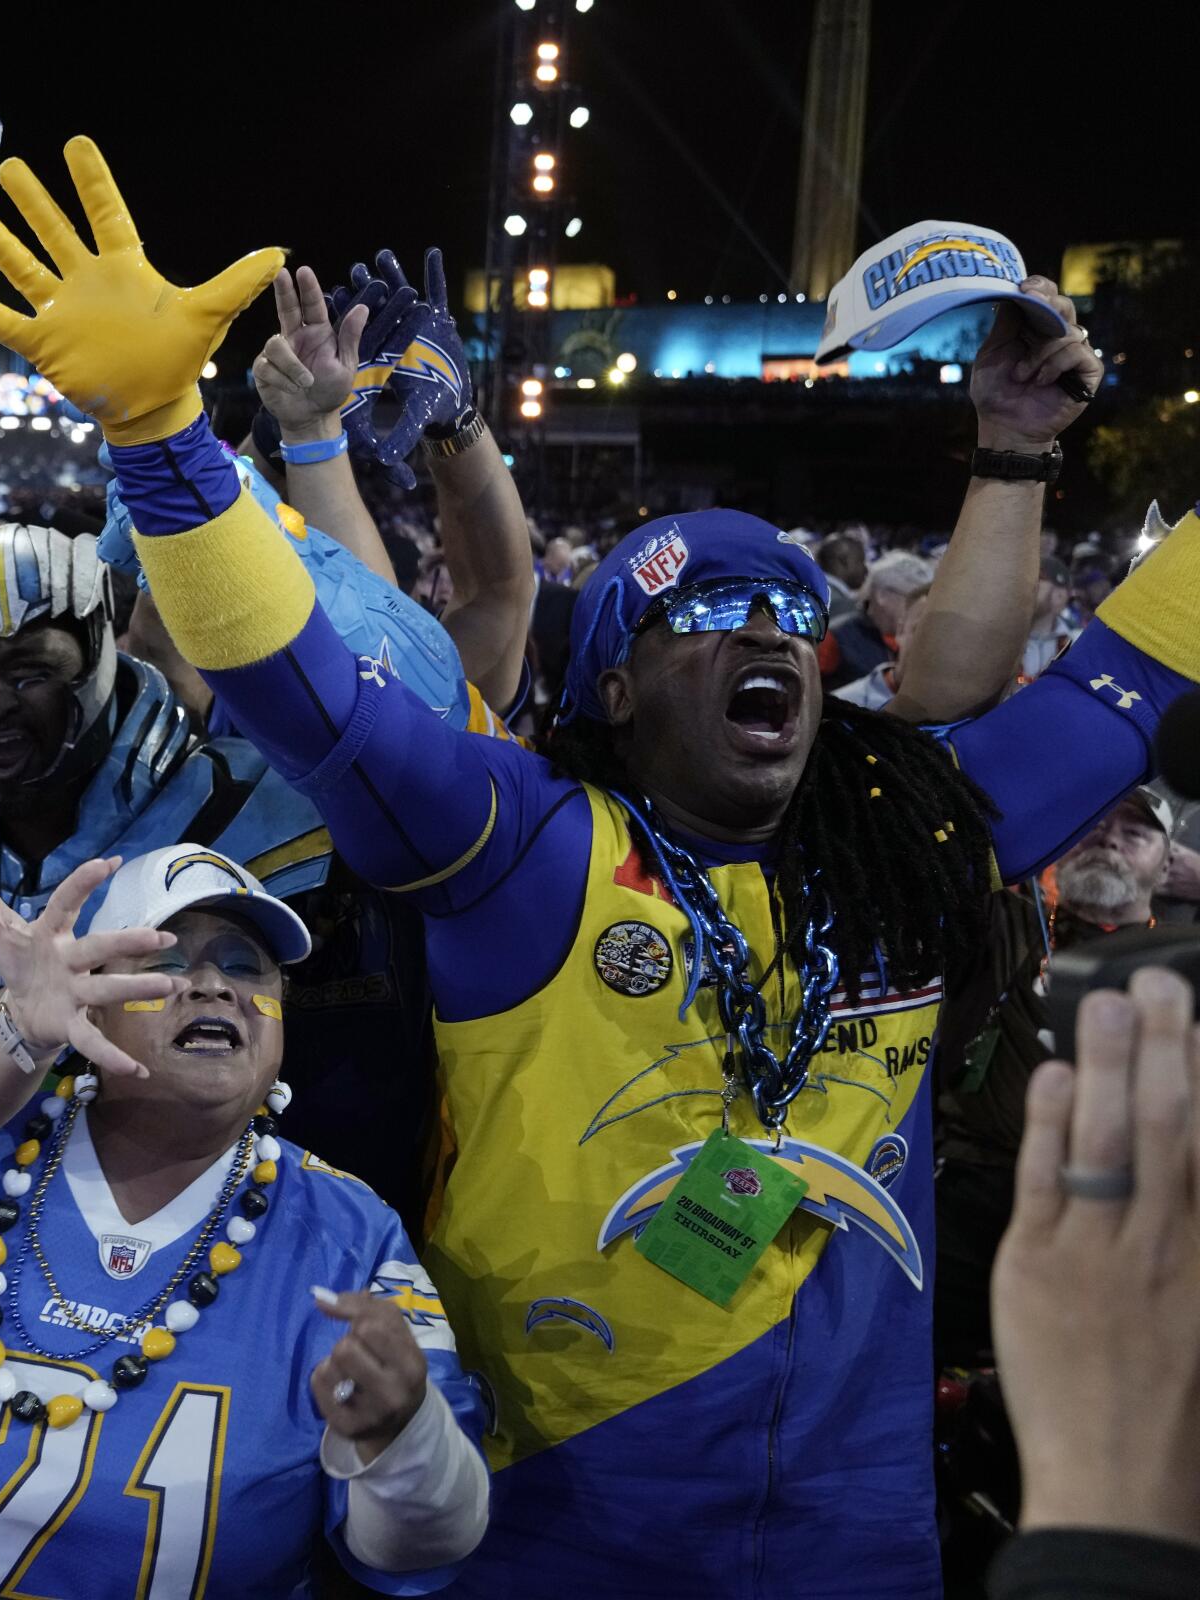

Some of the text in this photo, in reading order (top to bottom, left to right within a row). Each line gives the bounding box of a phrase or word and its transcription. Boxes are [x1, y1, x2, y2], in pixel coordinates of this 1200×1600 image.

[863, 234, 1022, 310] CHARGERS
[637, 544, 686, 592] NFL
[103, 1236, 147, 1250] EQUIPMENT
[673, 1211, 743, 1259] THURSDAY
[740, 1235, 758, 1250] ST
[110, 1255, 133, 1273] NFL
